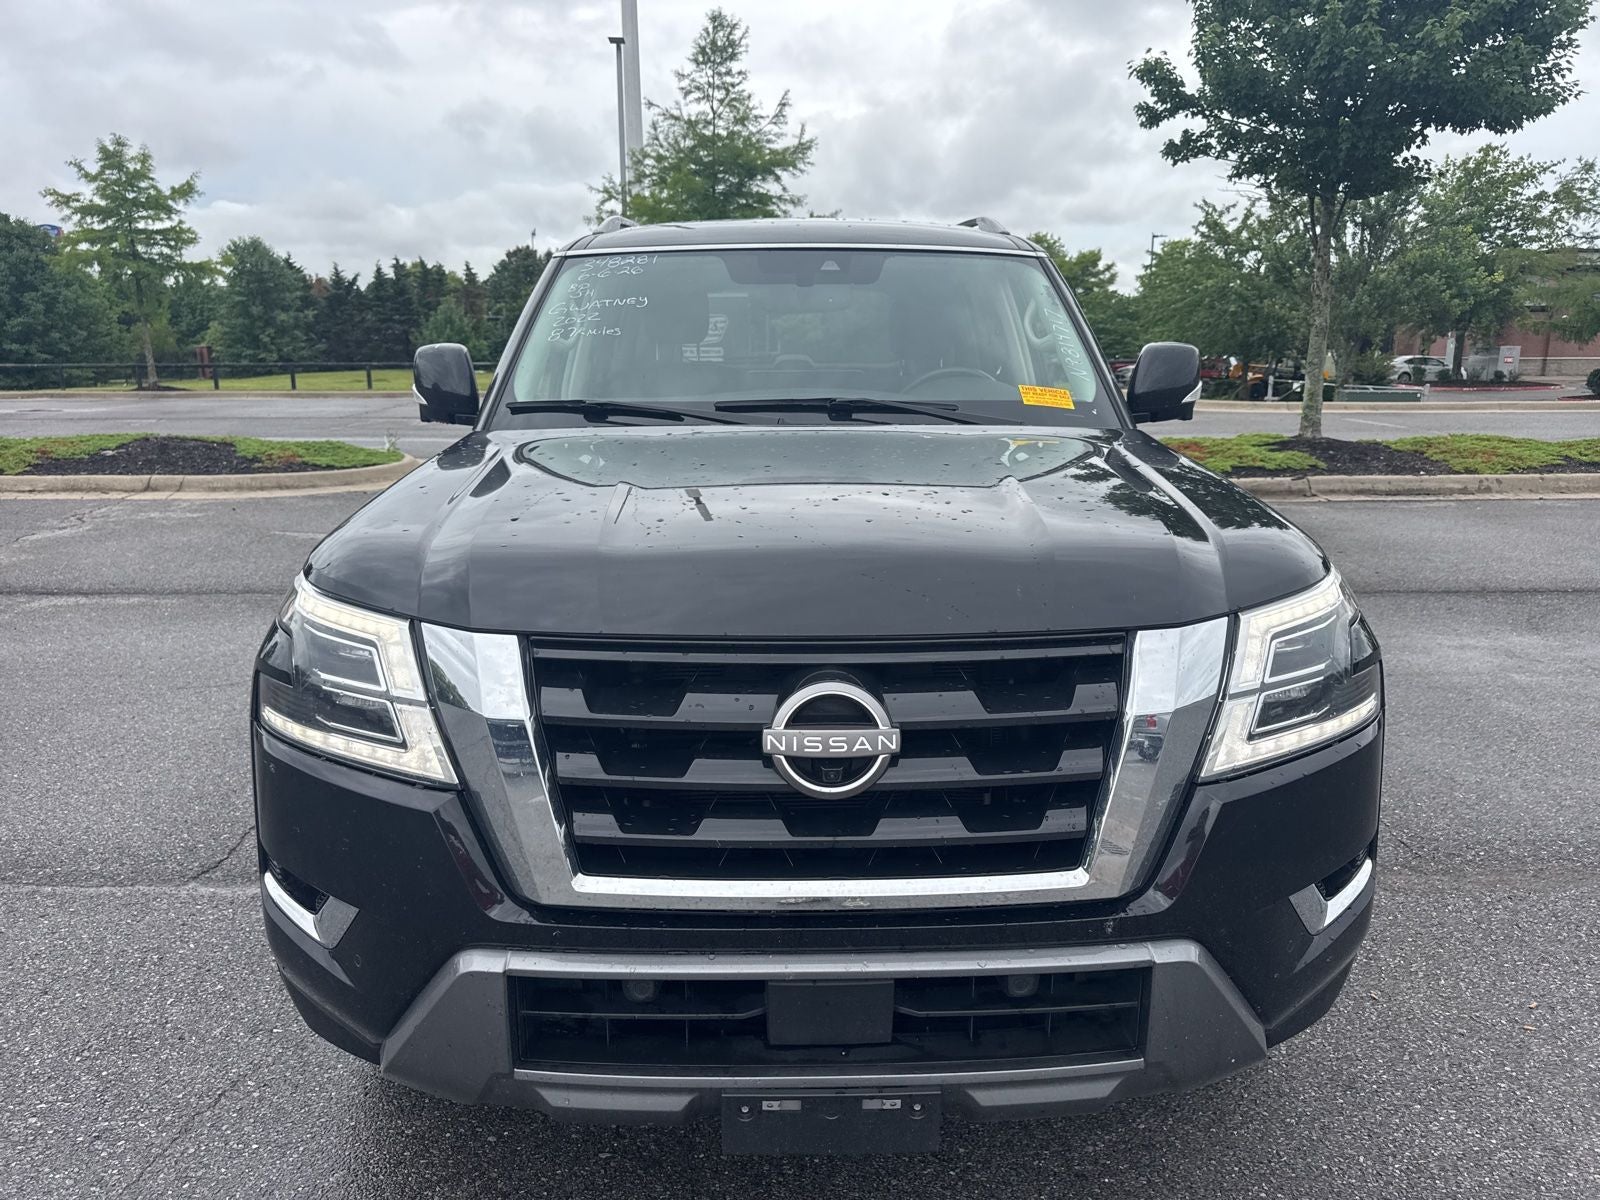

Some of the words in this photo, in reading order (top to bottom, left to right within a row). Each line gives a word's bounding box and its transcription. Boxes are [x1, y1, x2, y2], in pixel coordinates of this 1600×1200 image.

[548, 296, 648, 315] GWATNEY
[1039, 387, 1068, 395] VEHICLE
[766, 734, 896, 752] NISSAN
